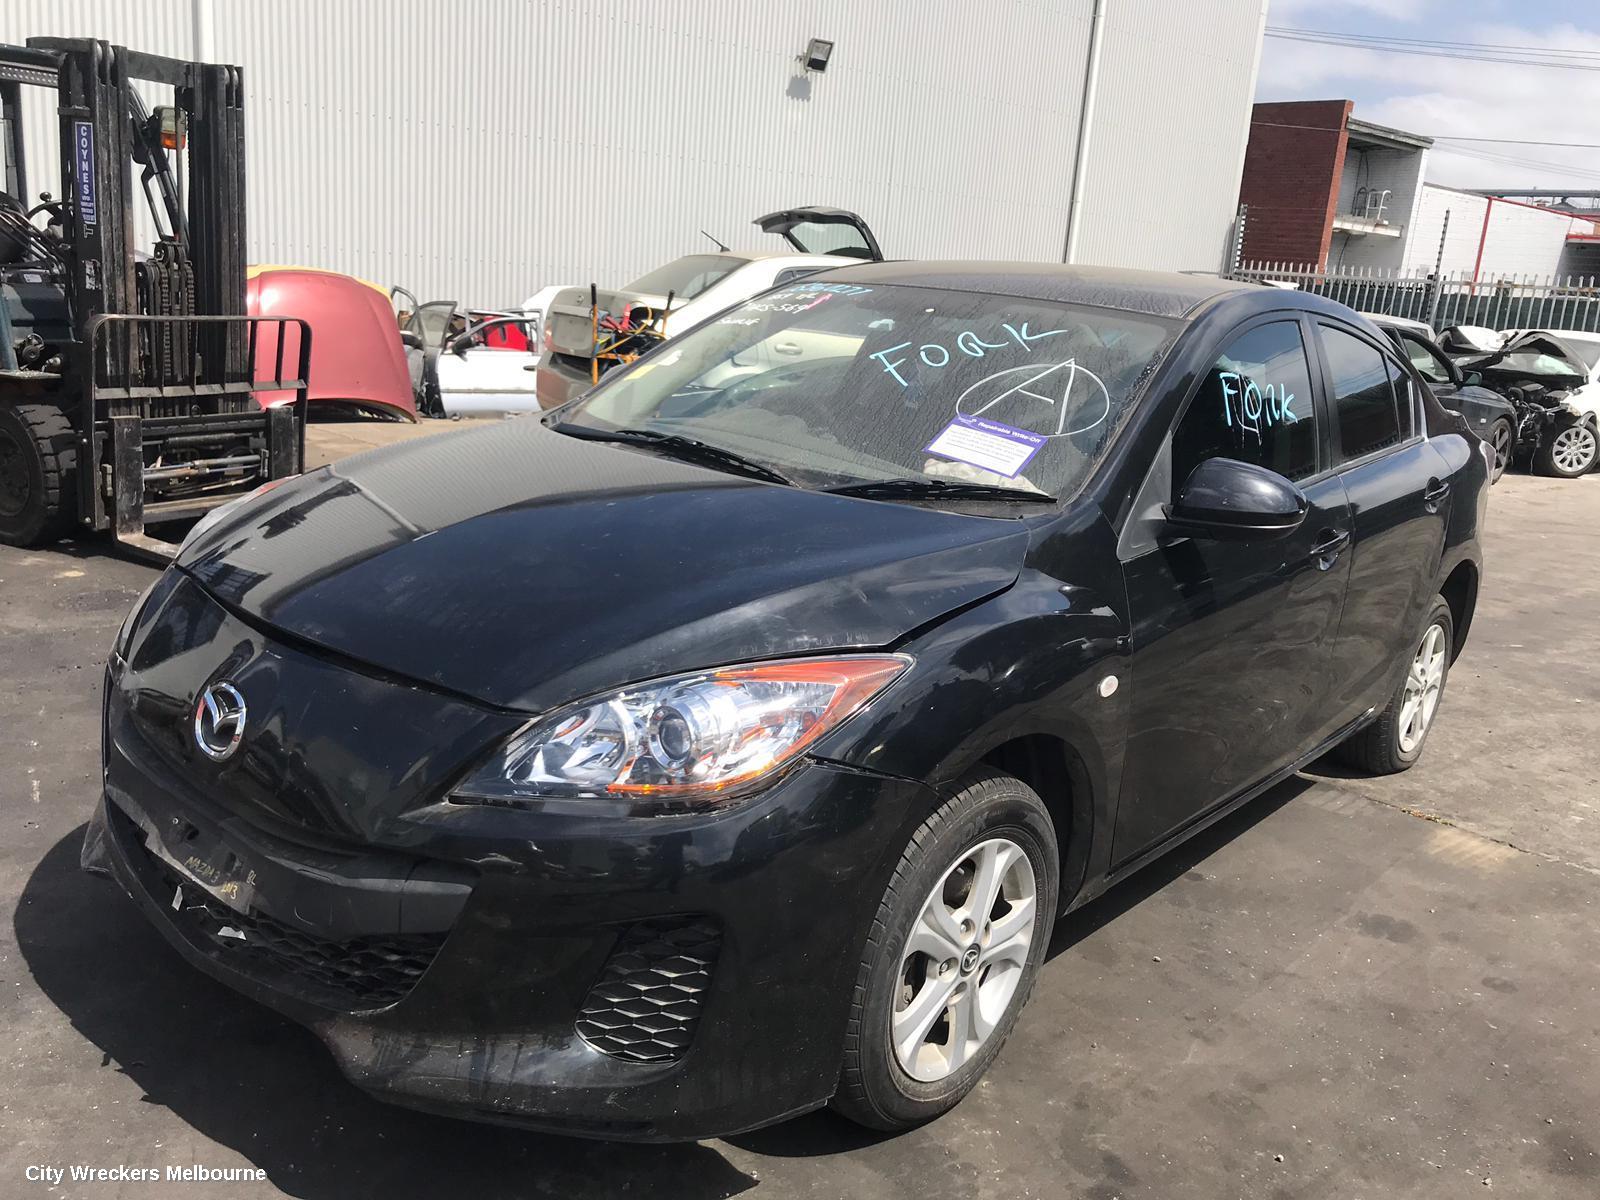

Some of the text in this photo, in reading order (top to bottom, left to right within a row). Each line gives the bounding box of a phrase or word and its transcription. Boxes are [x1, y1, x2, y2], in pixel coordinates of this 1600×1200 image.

[80, 126, 90, 195] COYNES
[977, 422, 1041, 443] Repairable Write-Off
